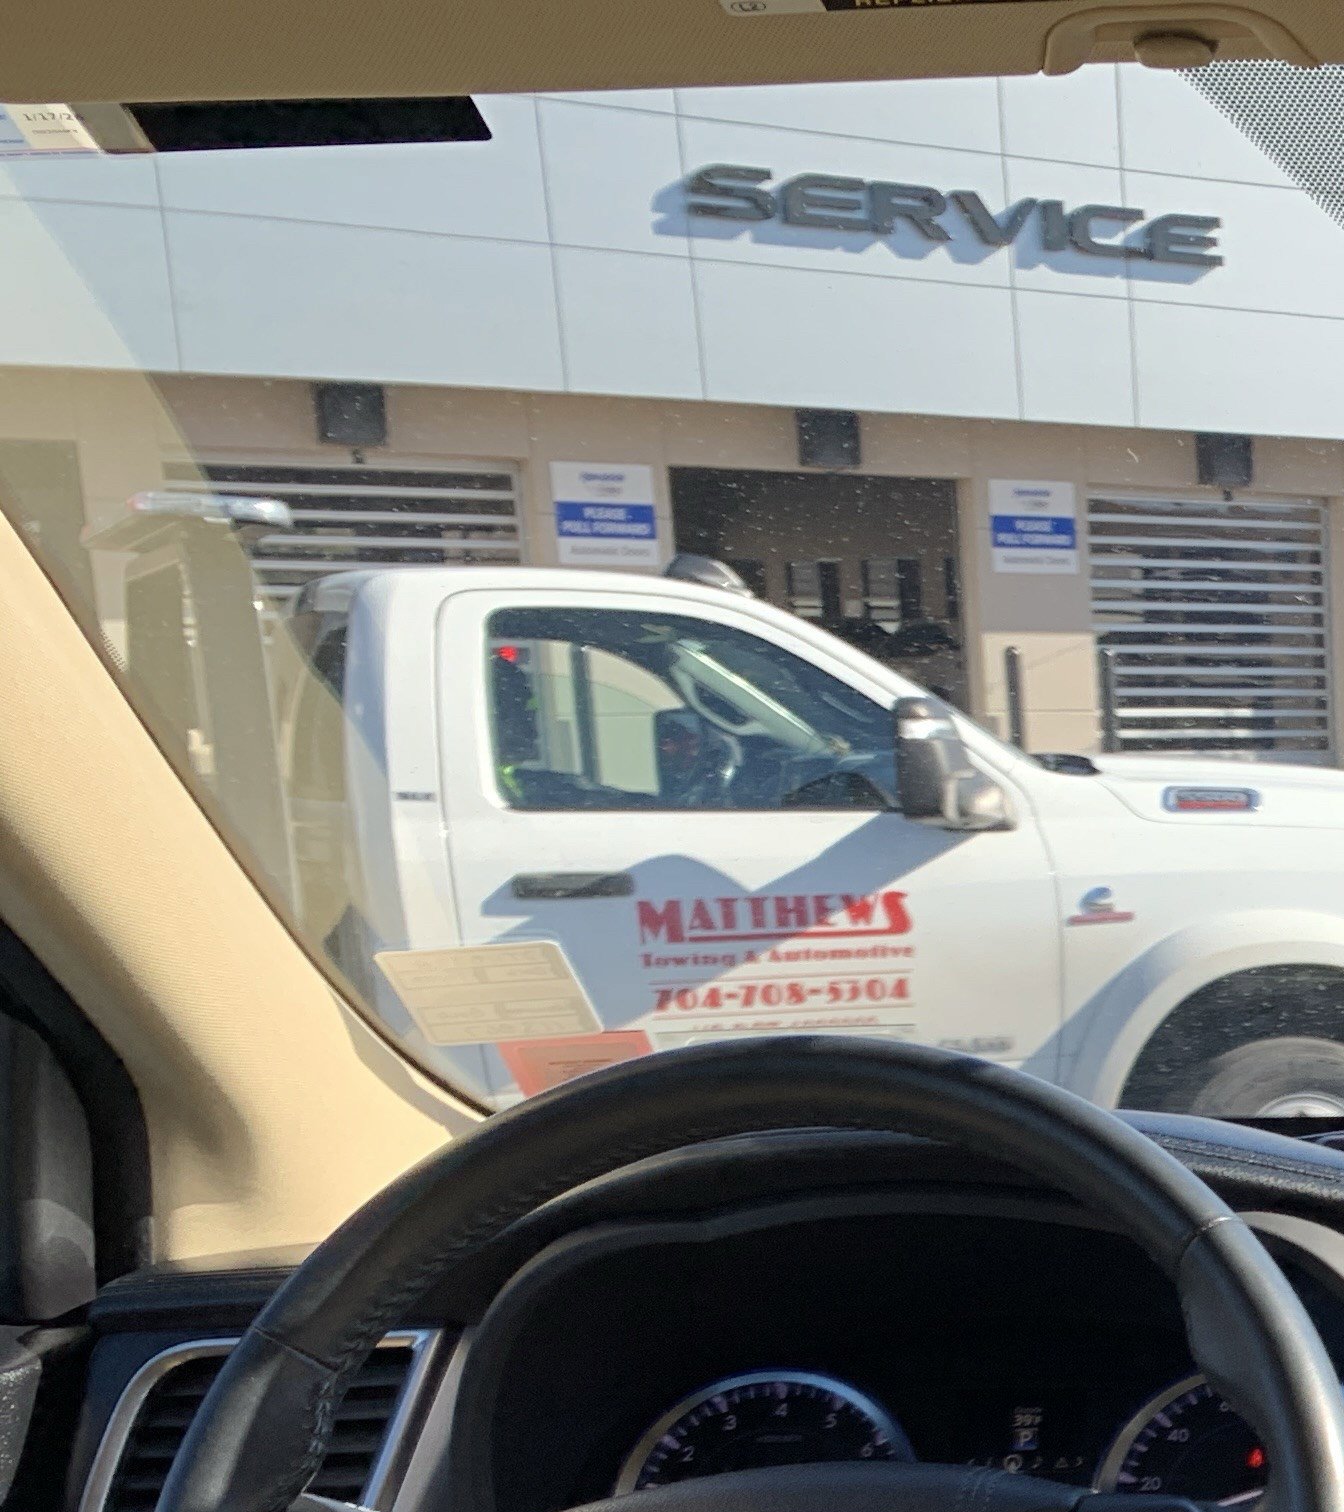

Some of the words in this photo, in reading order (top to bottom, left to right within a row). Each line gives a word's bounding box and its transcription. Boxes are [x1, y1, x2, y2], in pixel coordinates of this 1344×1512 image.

[684, 163, 1223, 267] SERVICE
[637, 890, 913, 944] MATTHEWS
[640, 951, 736, 968] Towing
[744, 949, 760, 963] &
[767, 945, 916, 964] Automotive
[773, 1403, 788, 1417] 4
[724, 1415, 737, 1430] 3
[824, 1414, 838, 1429] 5
[1167, 1428, 1189, 1441] 40
[683, 1446, 696, 1461] 2
[860, 1443, 874, 1457] 6
[1140, 1477, 1160, 1491] 20
